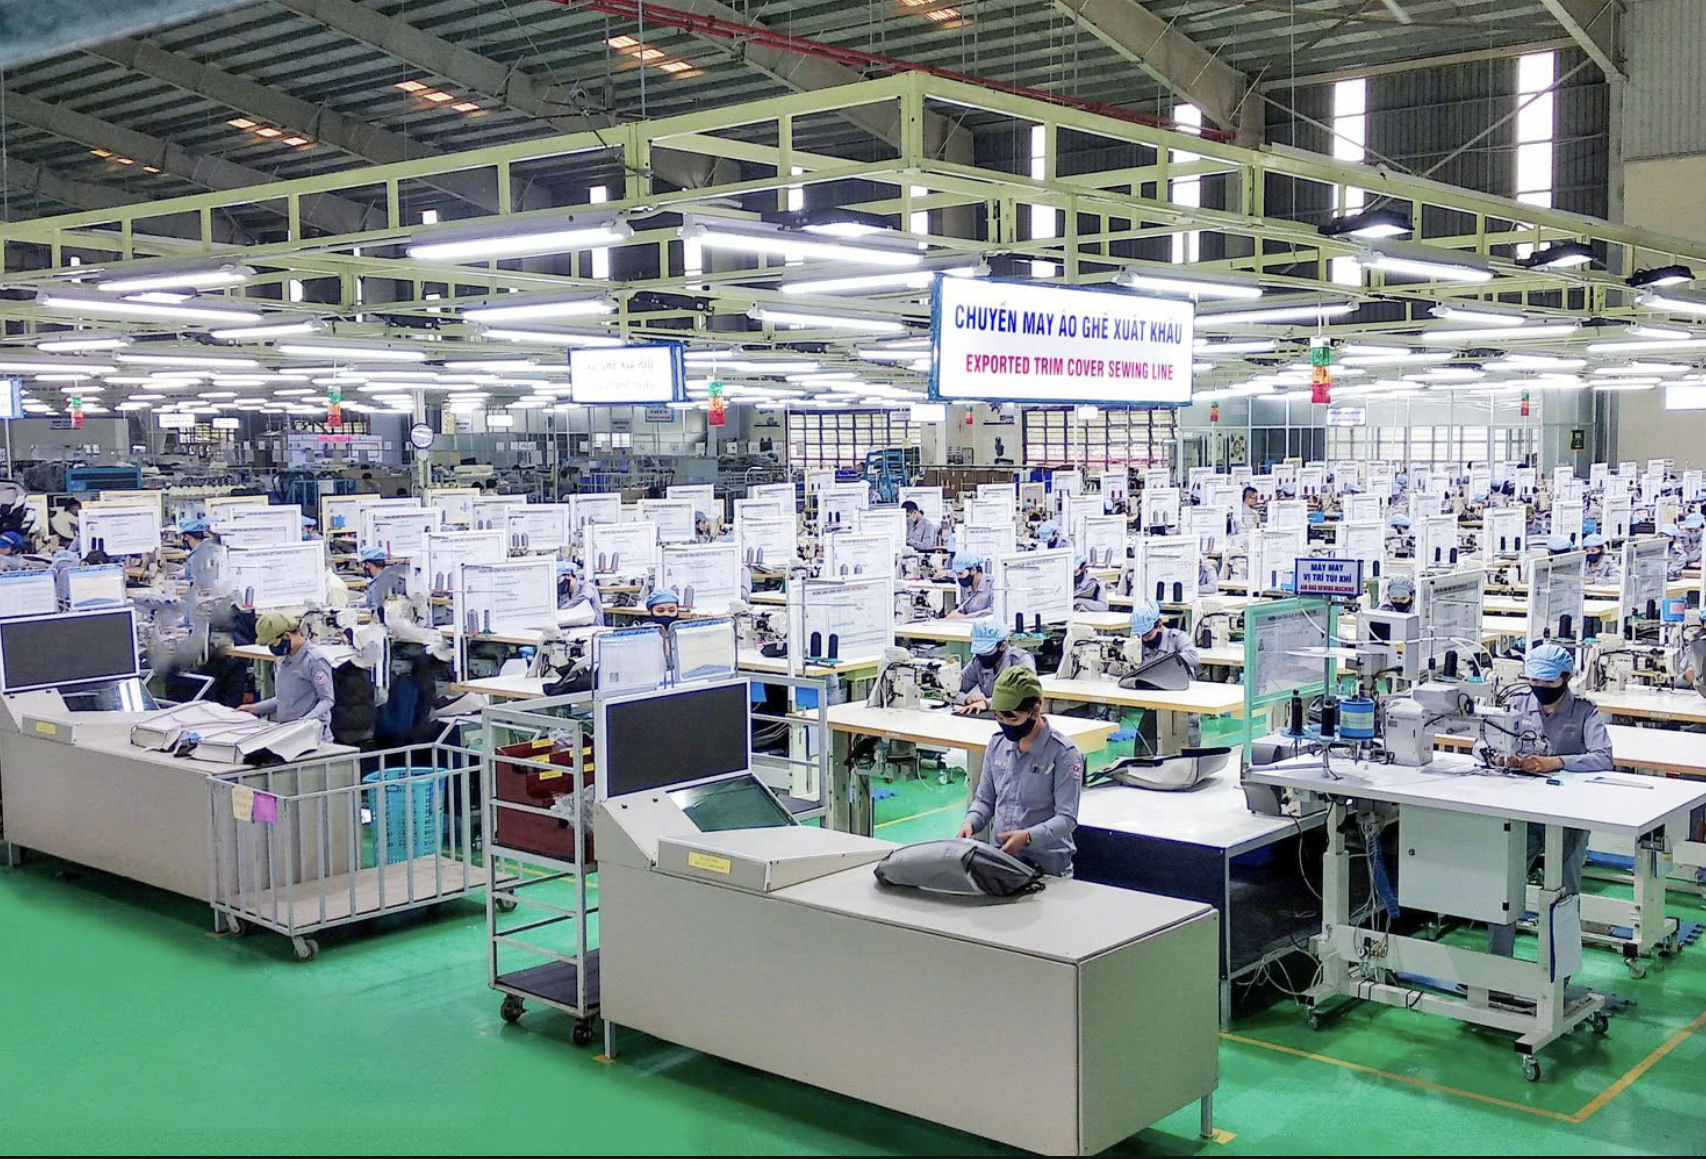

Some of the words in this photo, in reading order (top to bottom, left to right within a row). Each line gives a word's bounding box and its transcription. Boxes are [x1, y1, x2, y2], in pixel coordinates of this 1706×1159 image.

[1022, 310, 1054, 336] MAY
[966, 353, 1030, 374] EXPORTED
[1034, 357, 1064, 376] TRIM
[1067, 358, 1105, 378] COVER
[1108, 360, 1149, 380] SEWING
[1152, 363, 1174, 381] LINE
